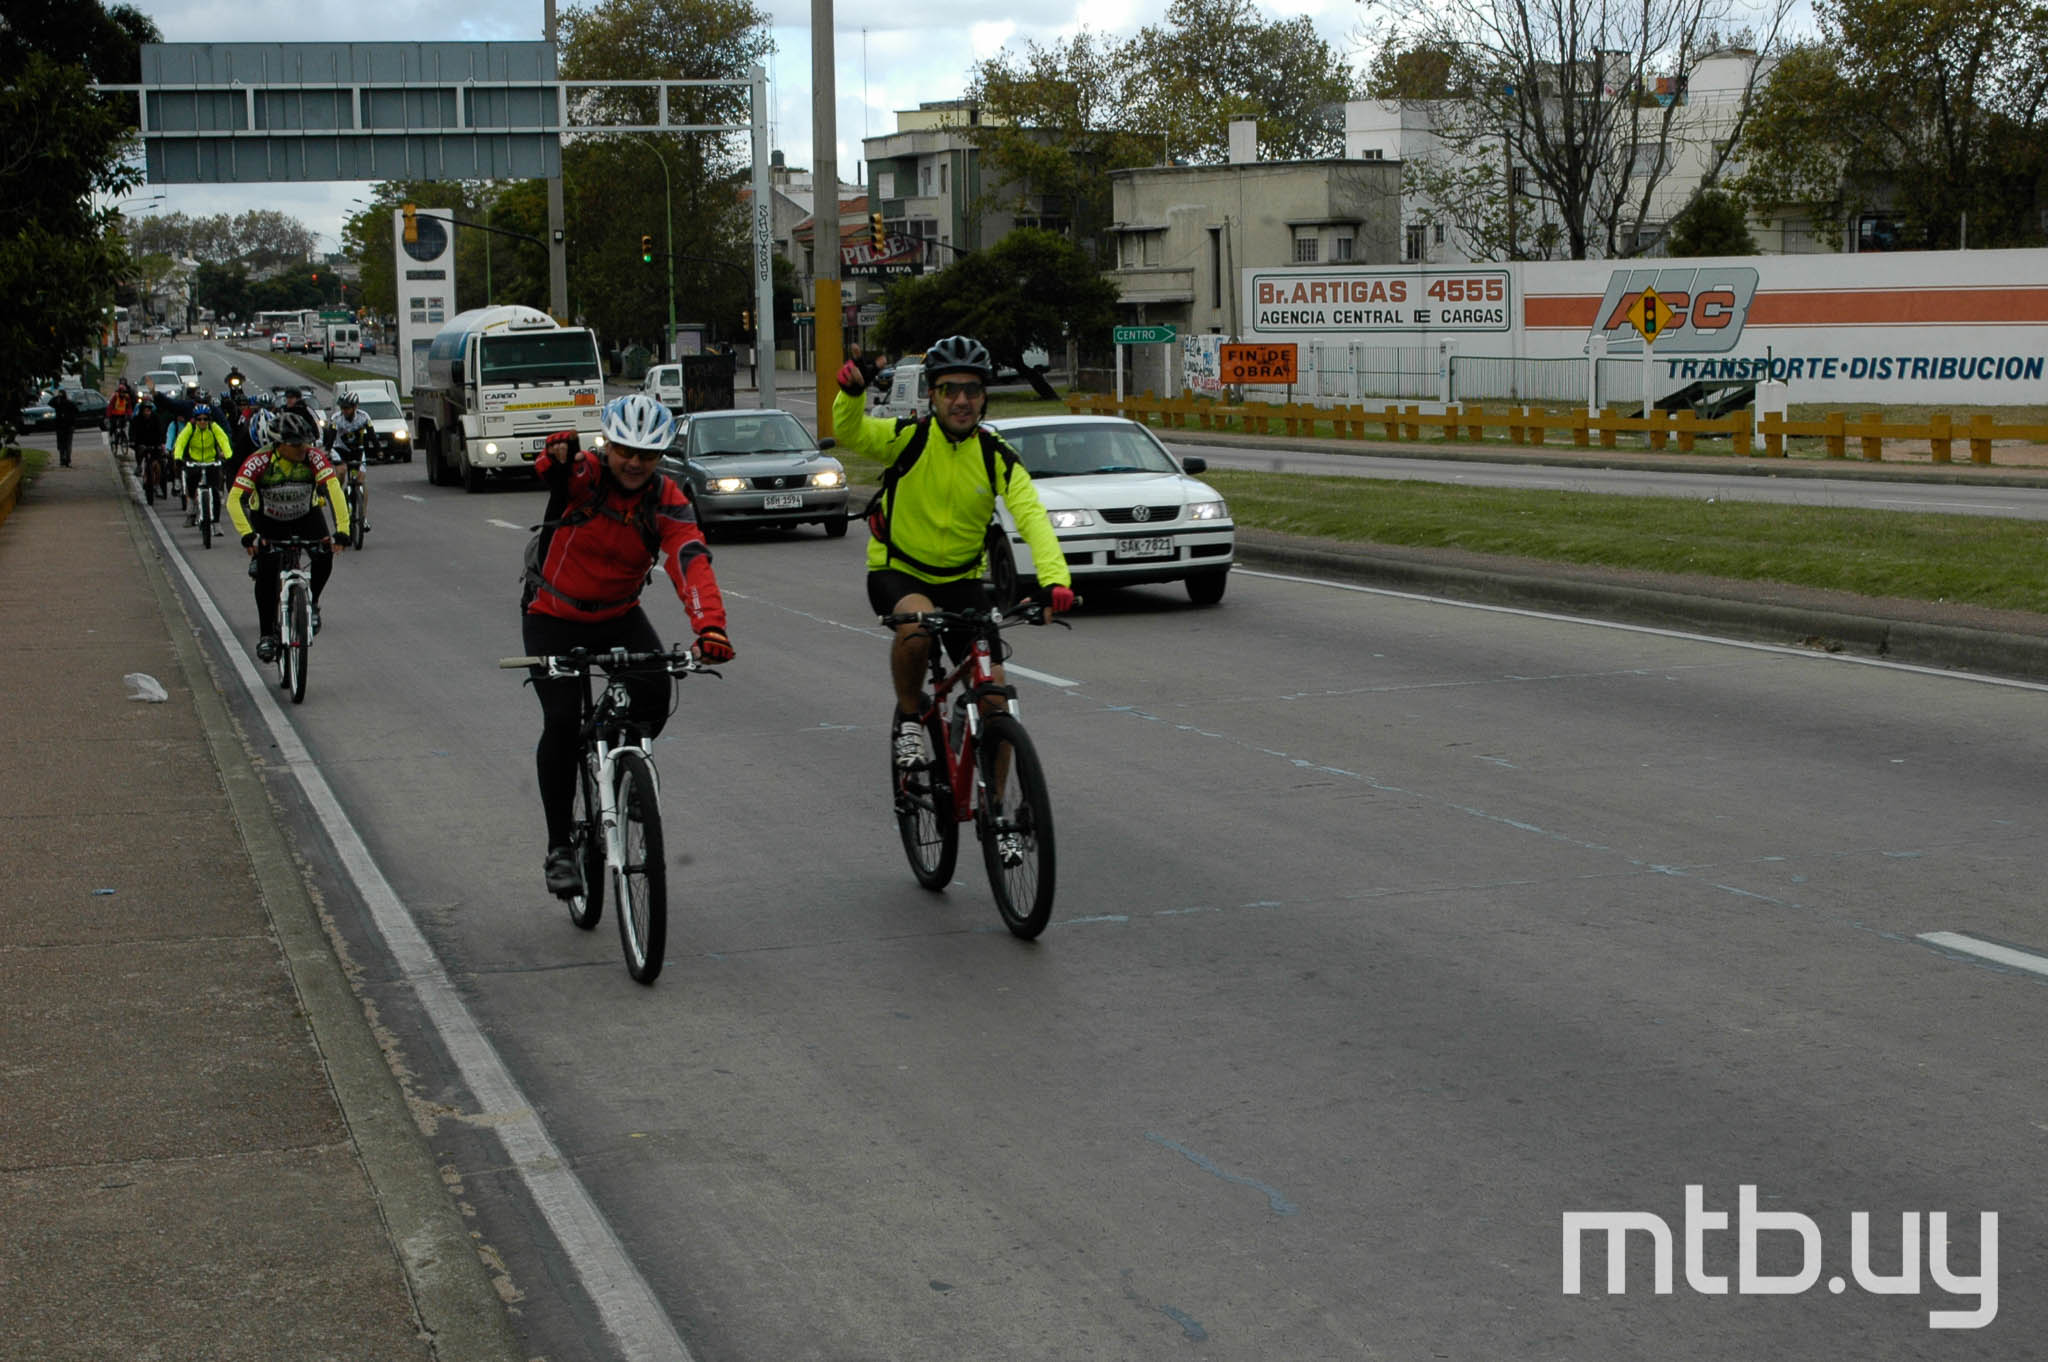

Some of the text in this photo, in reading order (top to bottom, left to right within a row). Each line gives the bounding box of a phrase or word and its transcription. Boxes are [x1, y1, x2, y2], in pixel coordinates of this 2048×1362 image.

[851, 266, 877, 274] BAR
[1427, 279, 1503, 302] 4555
[1260, 310, 1326, 324] AGENCIA
[1333, 310, 1403, 324] CENTRAL
[1441, 309, 1503, 323] CARGAS
[1117, 330, 1156, 340] CENTRO
[1228, 350, 1290, 361] FIN DE
[1233, 365, 1283, 377] OBRA
[485, 392, 517, 401] CARGO
